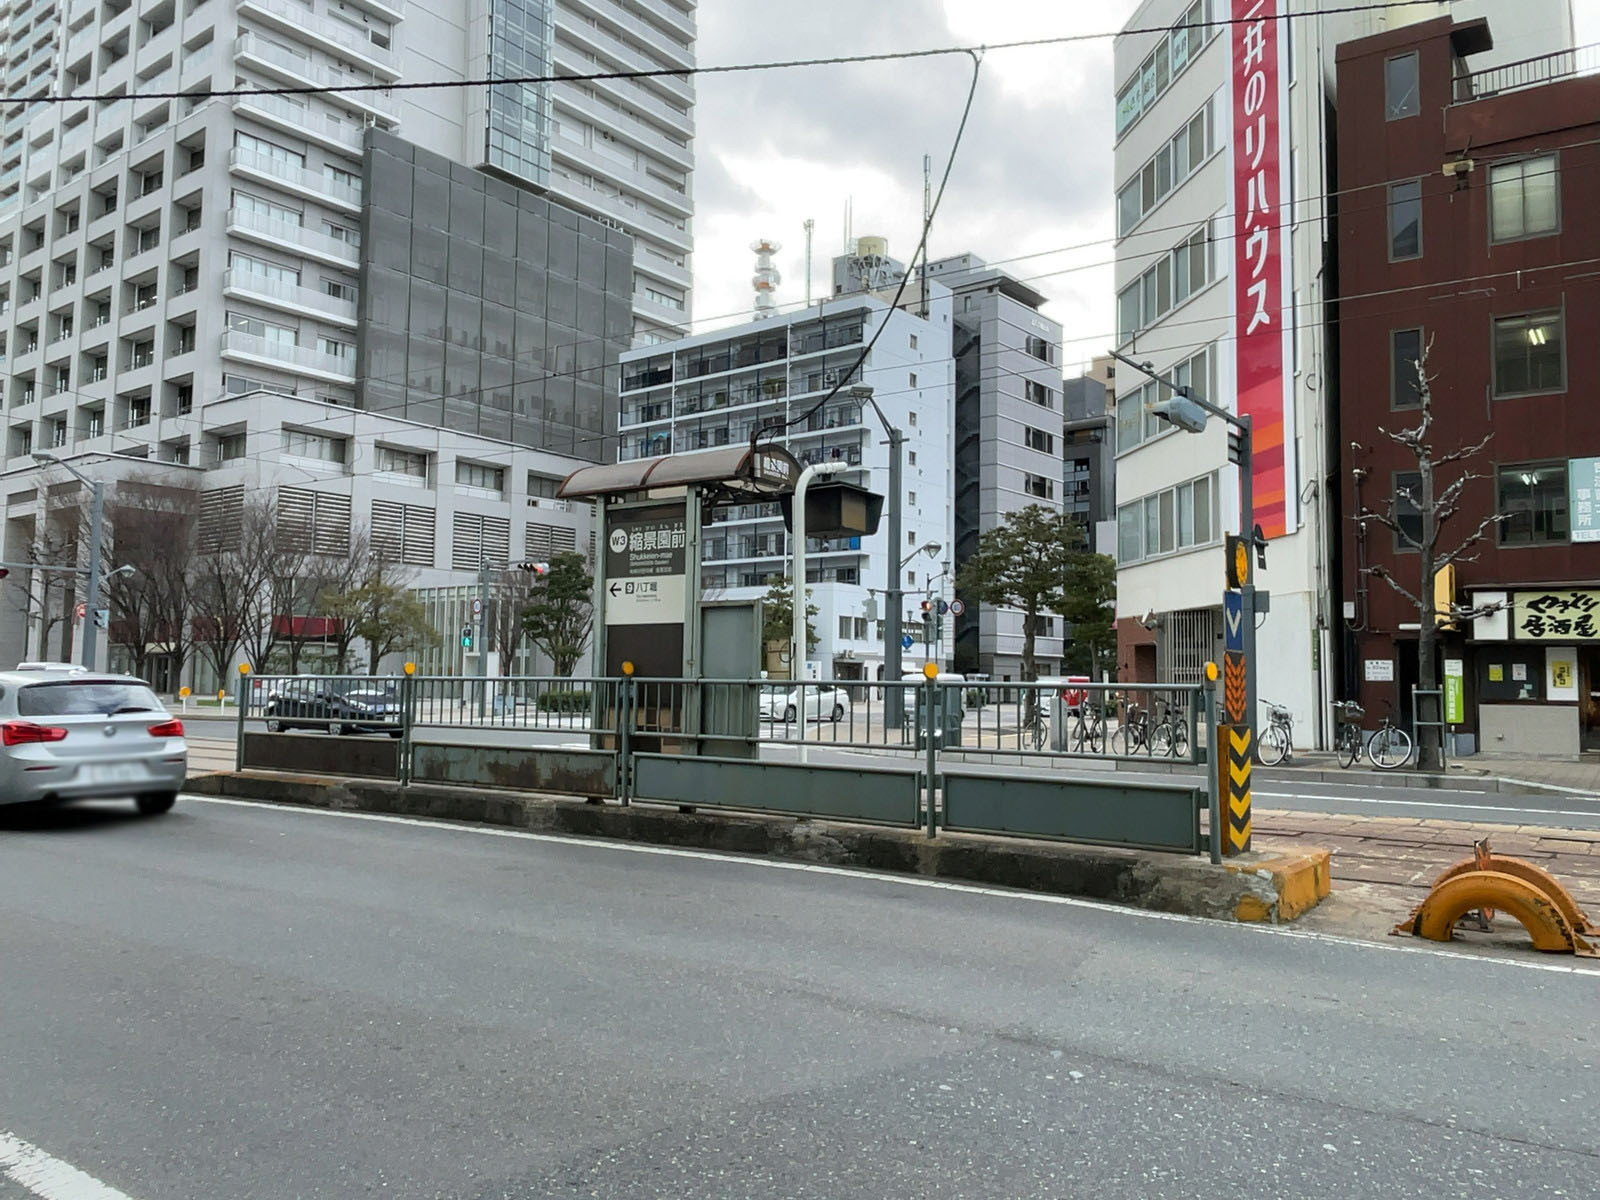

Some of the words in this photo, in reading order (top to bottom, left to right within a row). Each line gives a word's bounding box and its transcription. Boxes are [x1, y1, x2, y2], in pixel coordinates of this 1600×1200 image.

[611, 536, 626, 546] W3
[629, 528, 686, 551] 縮景園前
[1520, 613, 1598, 638] 居酒屋
